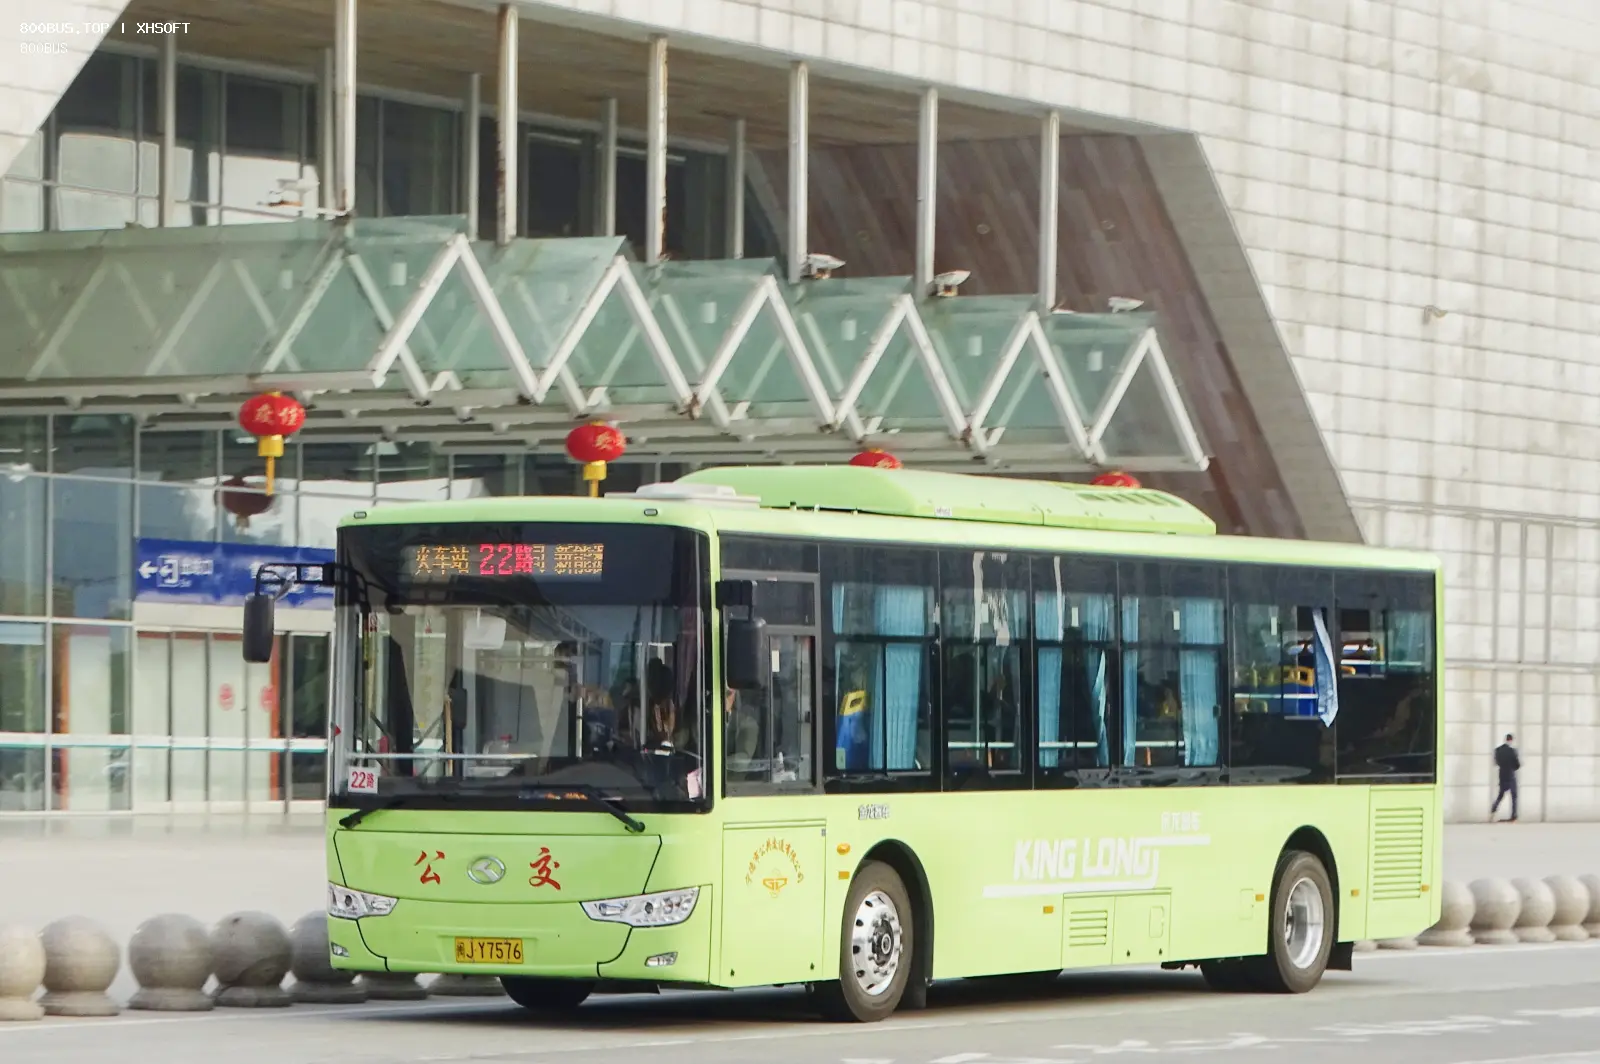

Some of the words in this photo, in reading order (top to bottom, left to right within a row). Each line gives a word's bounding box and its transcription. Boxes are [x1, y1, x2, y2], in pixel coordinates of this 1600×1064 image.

[414, 544, 470, 576] 火车站
[351, 771, 375, 788] 22路
[414, 850, 446, 885] 公
[528, 846, 562, 891] 交
[1013, 838, 1077, 881] KING
[1081, 836, 1158, 882] LONG
